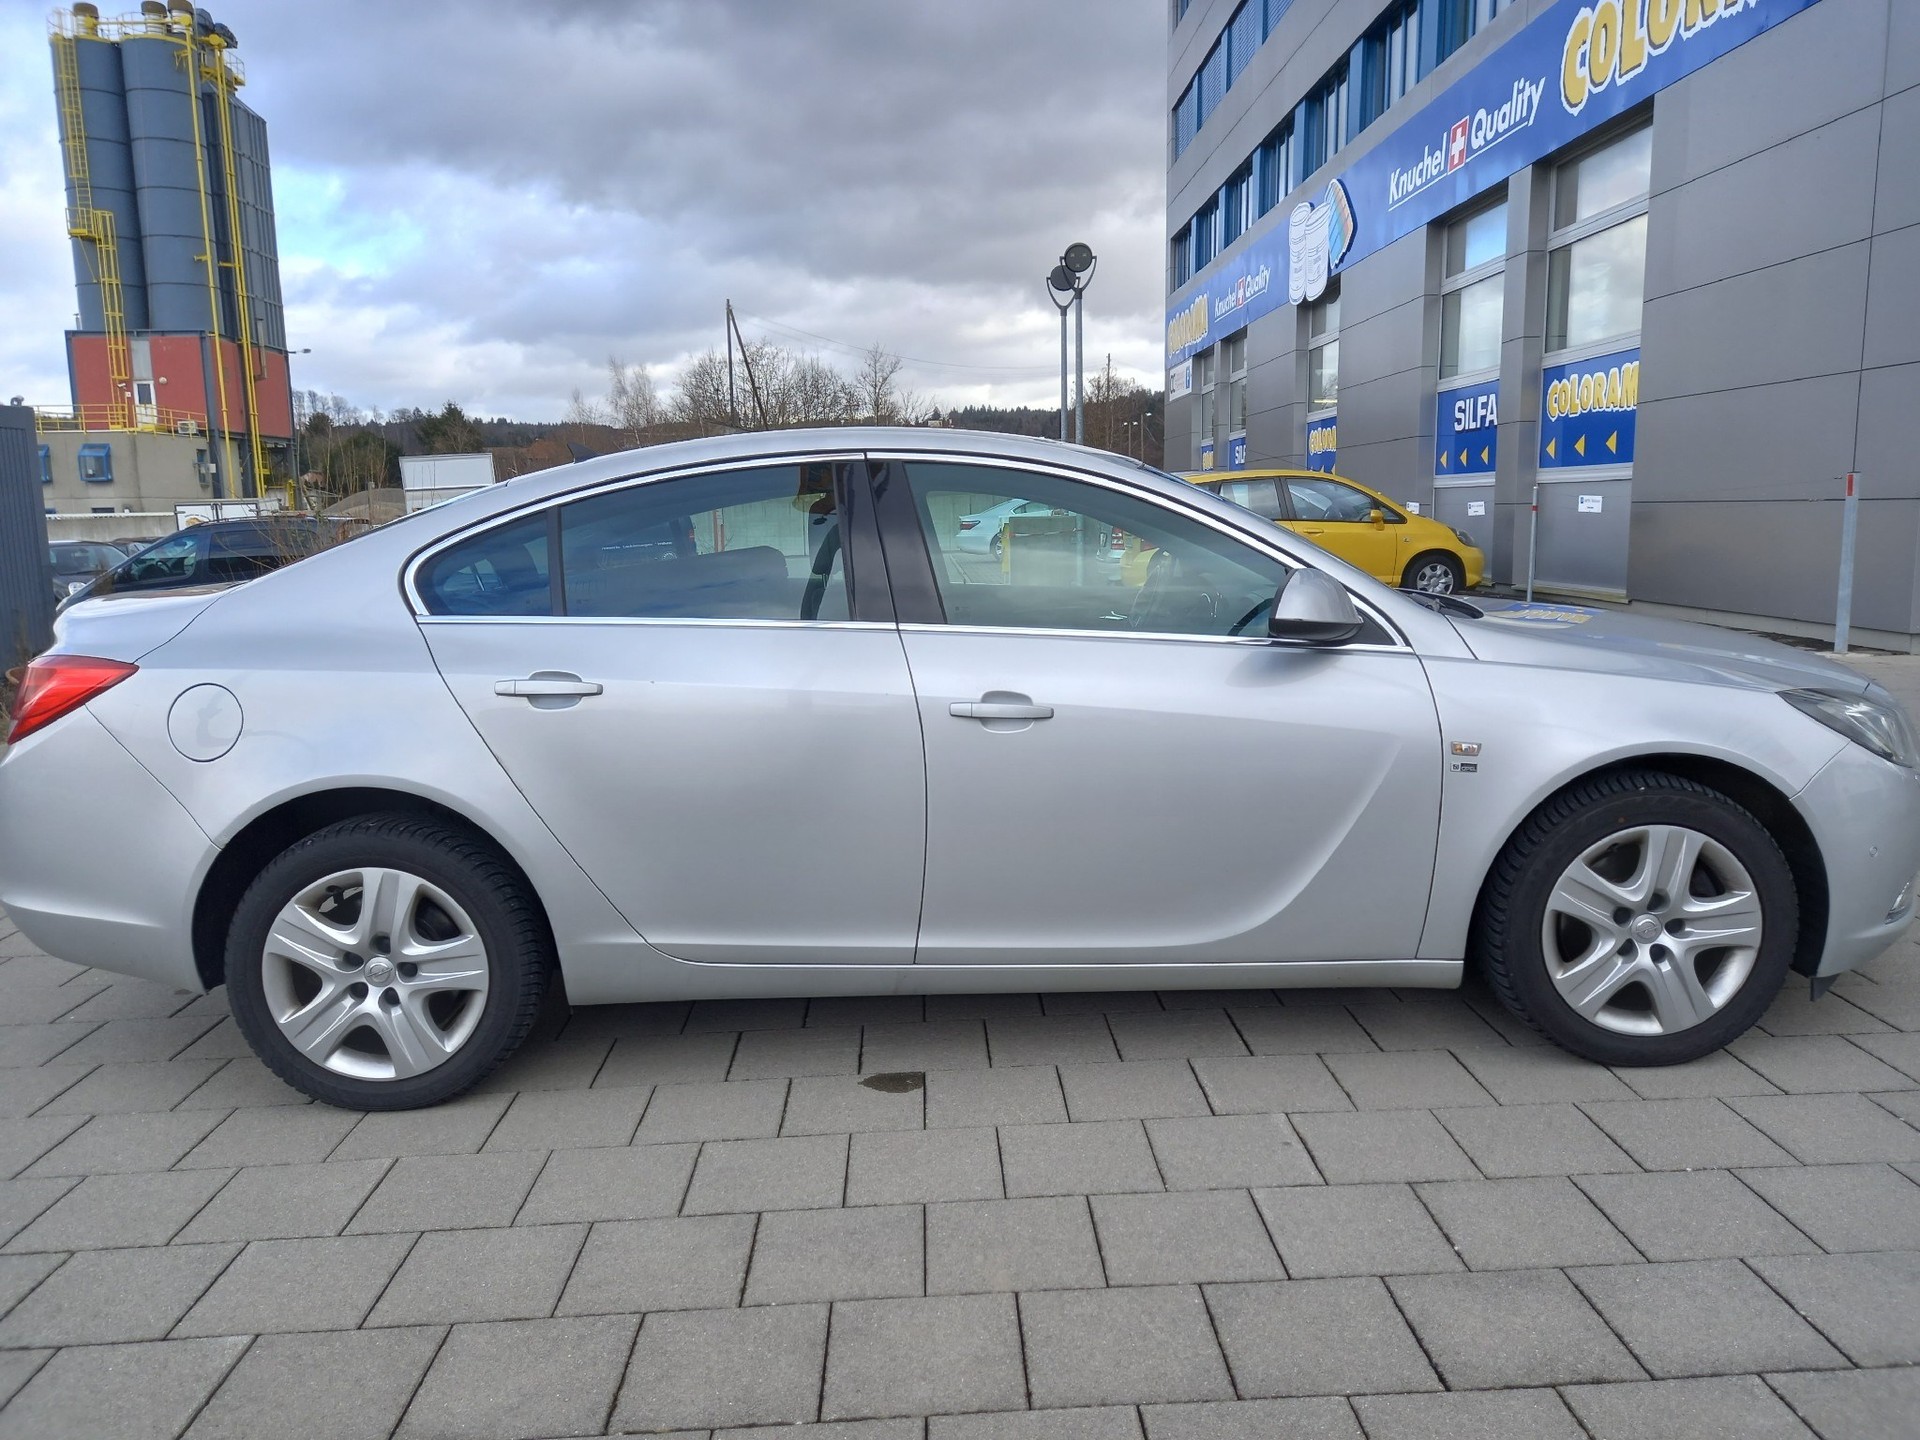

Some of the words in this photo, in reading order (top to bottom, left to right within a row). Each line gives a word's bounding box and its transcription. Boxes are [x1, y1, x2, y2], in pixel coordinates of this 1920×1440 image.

[1389, 132, 1447, 205] Knuchel
[1471, 77, 1546, 150] Quality
[1214, 282, 1237, 318] Knuchel
[1245, 264, 1271, 298] Quality
[1454, 393, 1498, 432] SILFA
[1547, 361, 1639, 422] COLORAM
